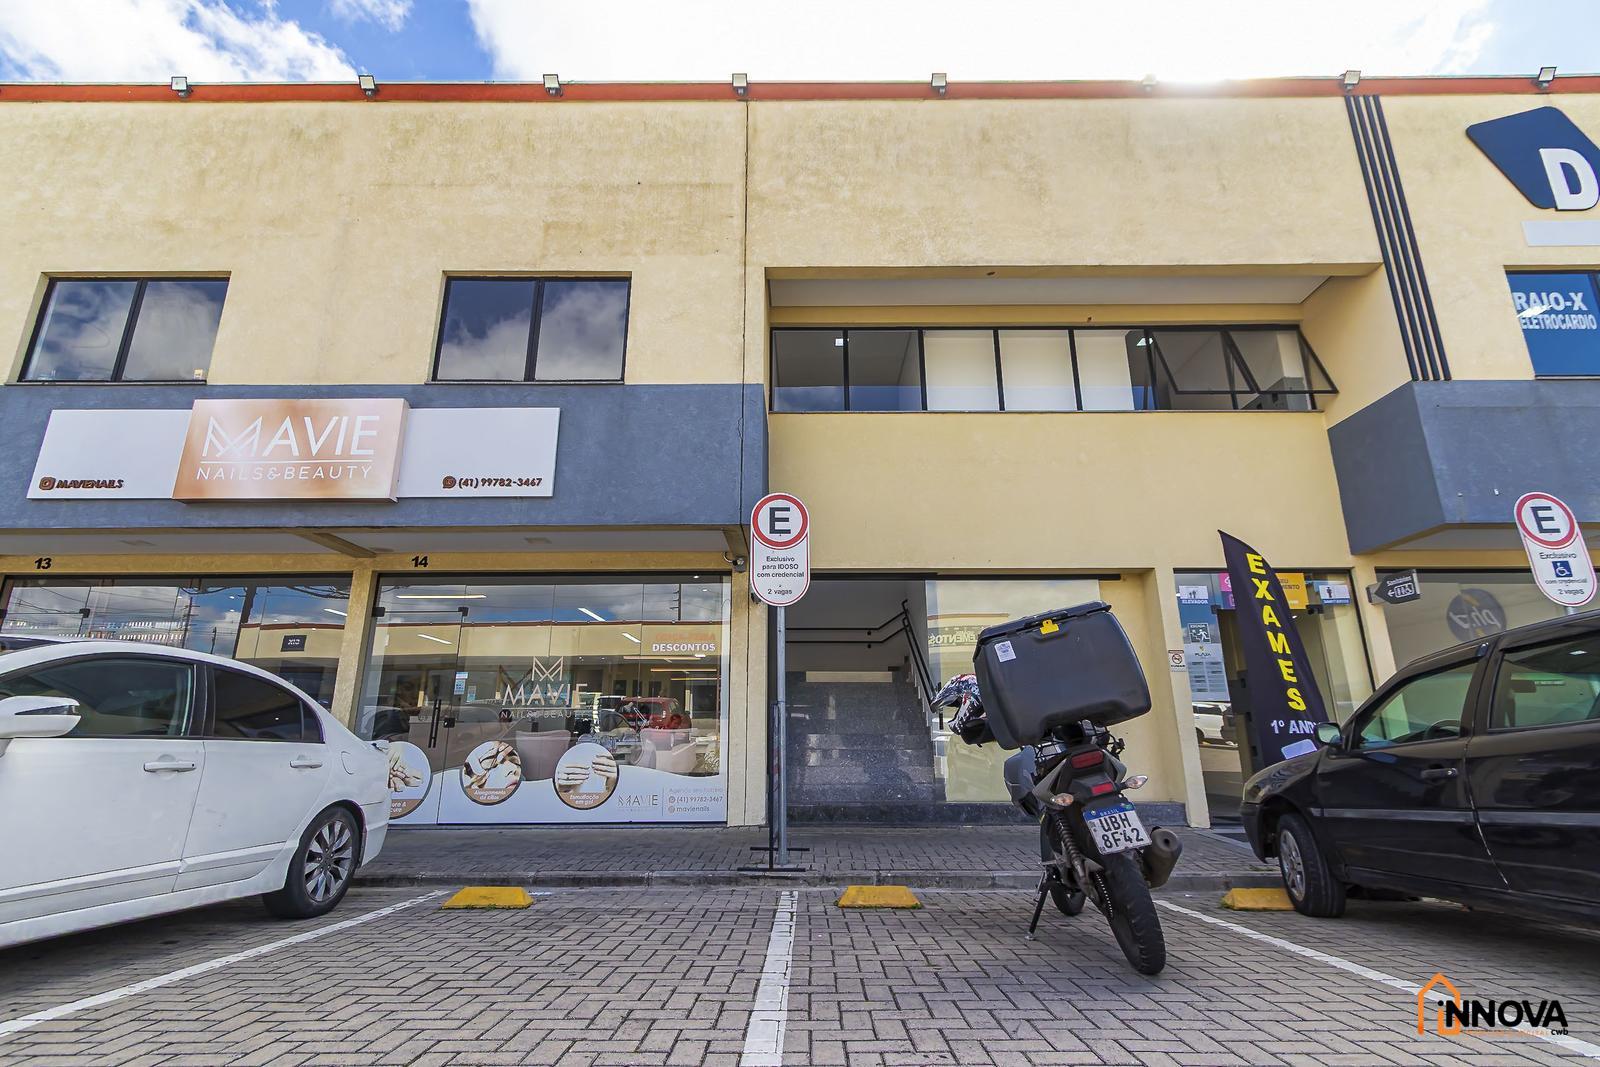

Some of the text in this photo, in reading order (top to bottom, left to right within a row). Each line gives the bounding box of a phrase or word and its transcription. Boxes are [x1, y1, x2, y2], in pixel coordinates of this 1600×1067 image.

[1511, 292, 1588, 311] RAIO-X
[1520, 313, 1597, 330] ELETROCARDIO
[202, 415, 380, 457] MAVIE
[458, 477, 543, 489] (41) 99782-3467
[769, 506, 791, 535] E
[1529, 505, 1562, 534] E
[34, 557, 52, 570] 13
[411, 555, 429, 568] 14
[766, 555, 796, 563] Exclusivo
[1538, 551, 1577, 560] Exclusivo
[773, 588, 793, 596] vagas
[1245, 553, 1307, 711] EXAMES
[652, 643, 716, 652] DESCONTOS
[501, 683, 588, 709] MAVIE
[1098, 812, 1132, 832] UBH
[1101, 827, 1144, 849] 8F42
